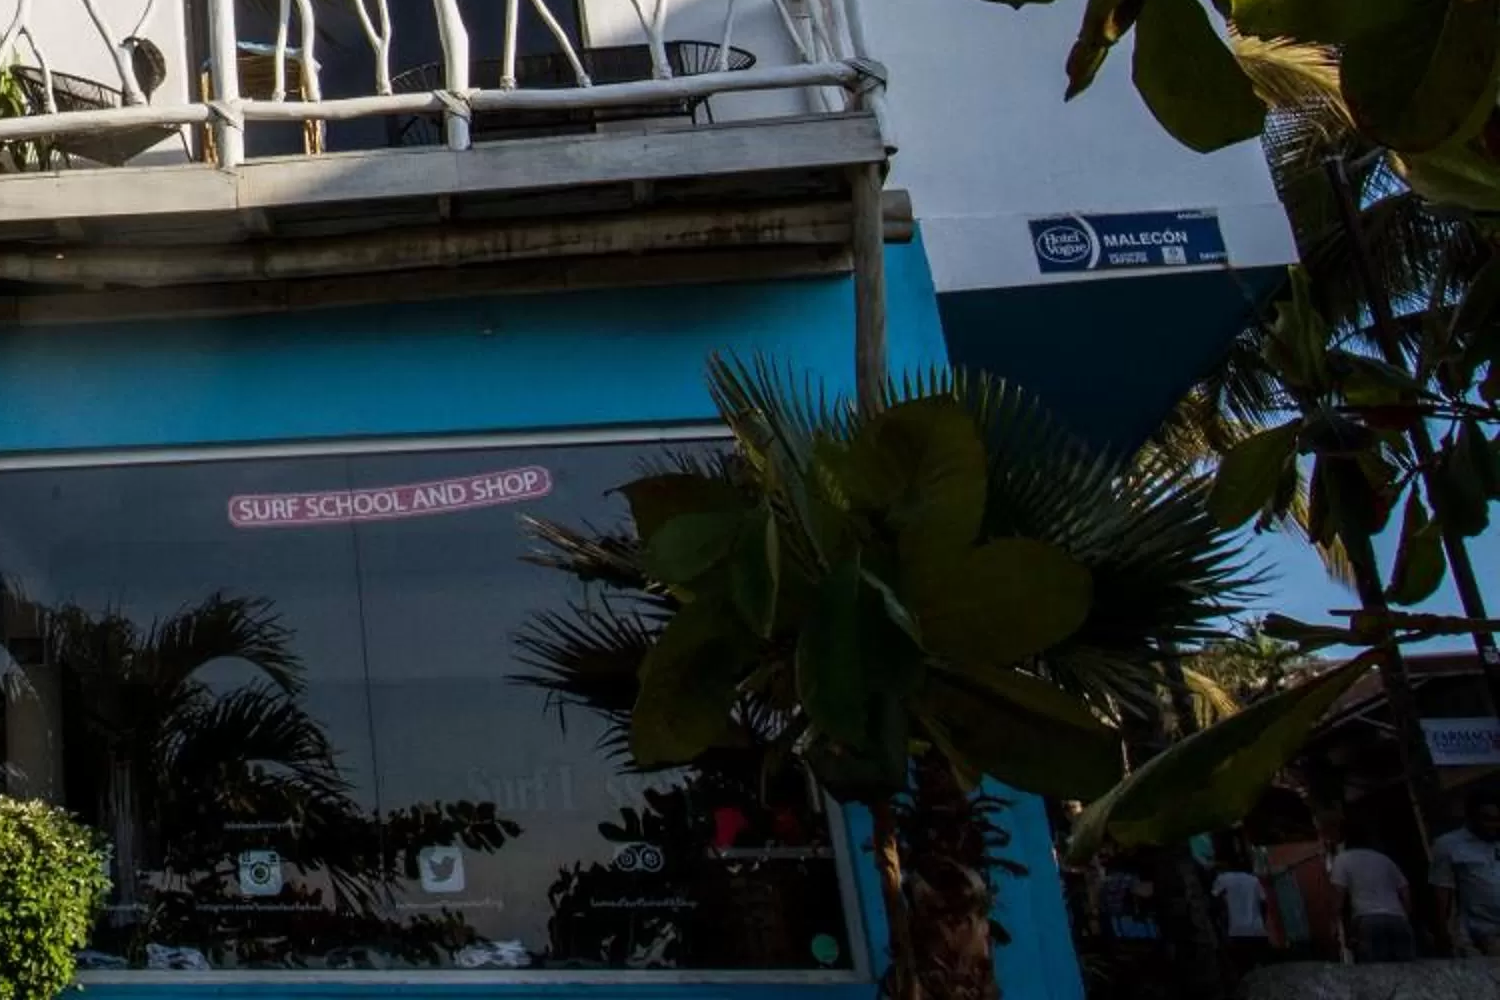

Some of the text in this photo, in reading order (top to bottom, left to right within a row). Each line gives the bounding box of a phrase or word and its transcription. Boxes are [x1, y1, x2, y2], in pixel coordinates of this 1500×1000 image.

[1103, 229, 1188, 247] MALECÓN
[239, 470, 538, 521] SURF SCHOOL AND SHOP
